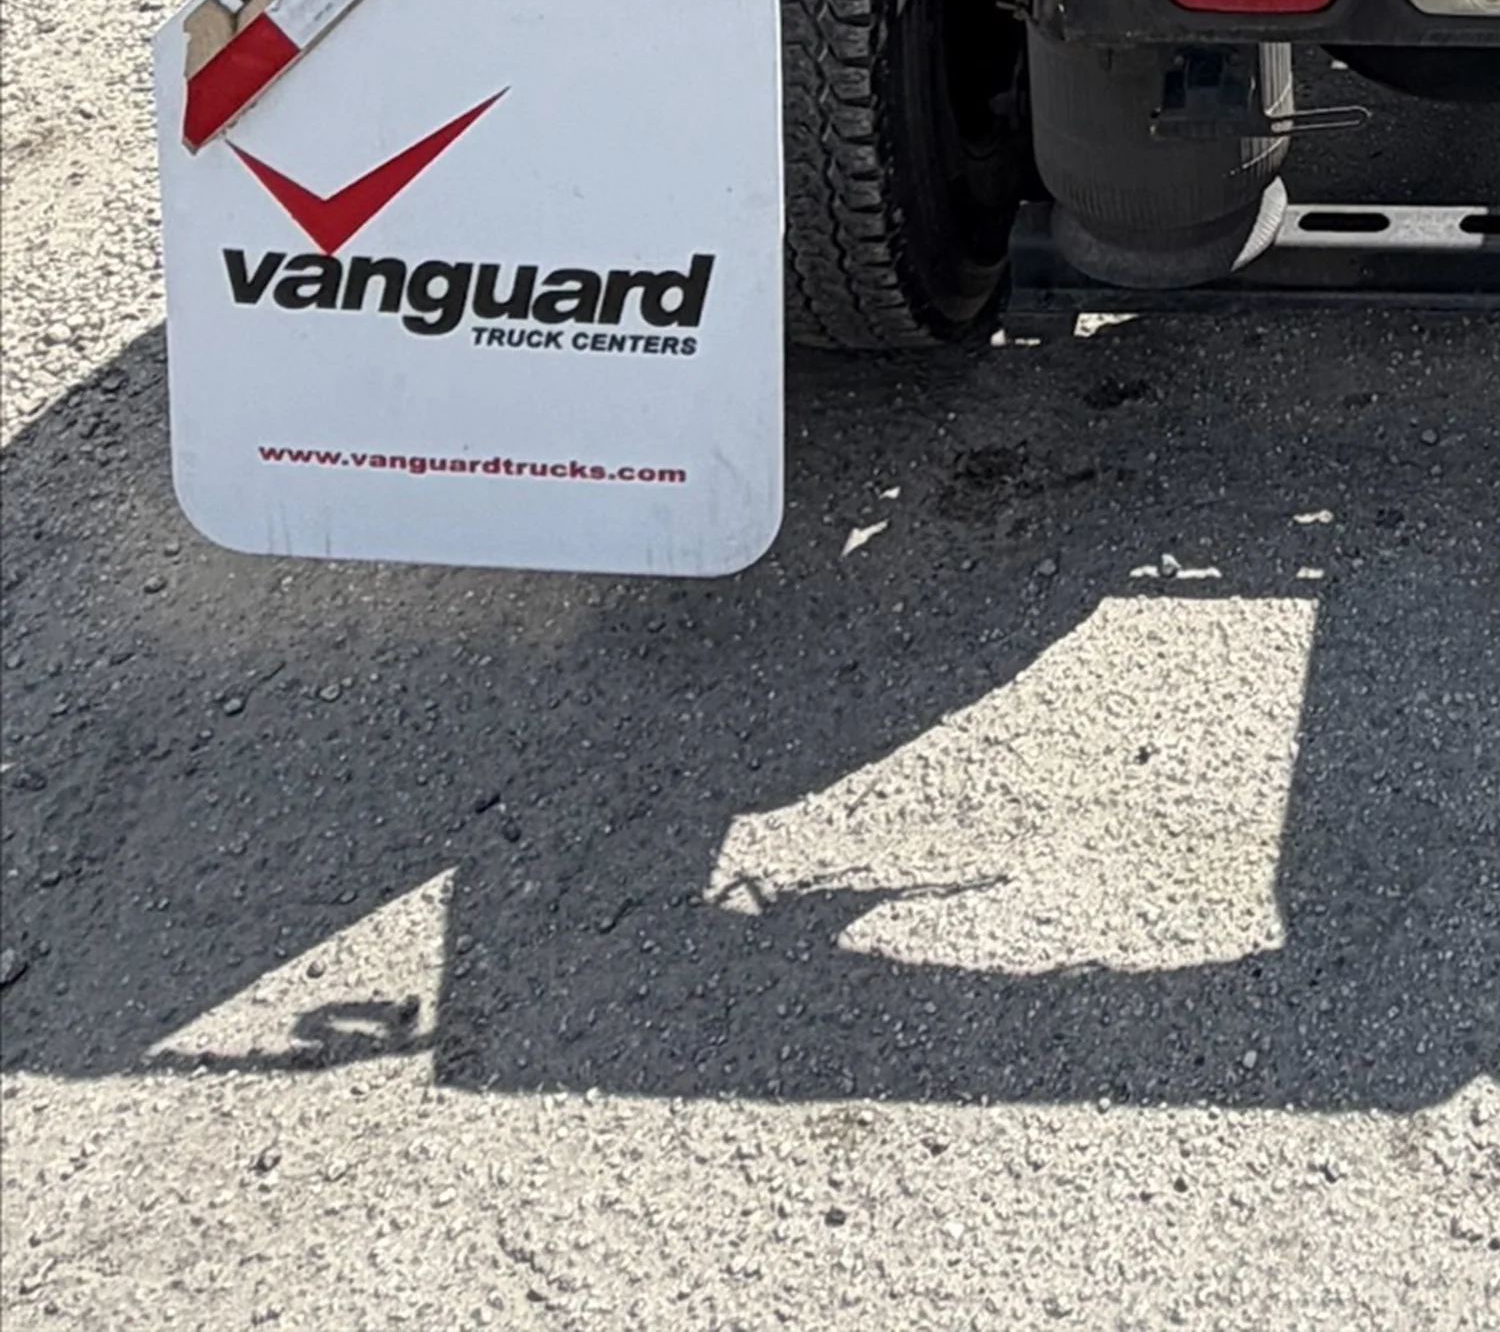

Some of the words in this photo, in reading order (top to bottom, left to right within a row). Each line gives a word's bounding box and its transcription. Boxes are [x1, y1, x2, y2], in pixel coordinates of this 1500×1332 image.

[223, 248, 715, 335] vanguard
[473, 328, 564, 349] TRUCK
[571, 332, 697, 356] CENTERS
[258, 446, 687, 484] www.vanguardtrucks.com
